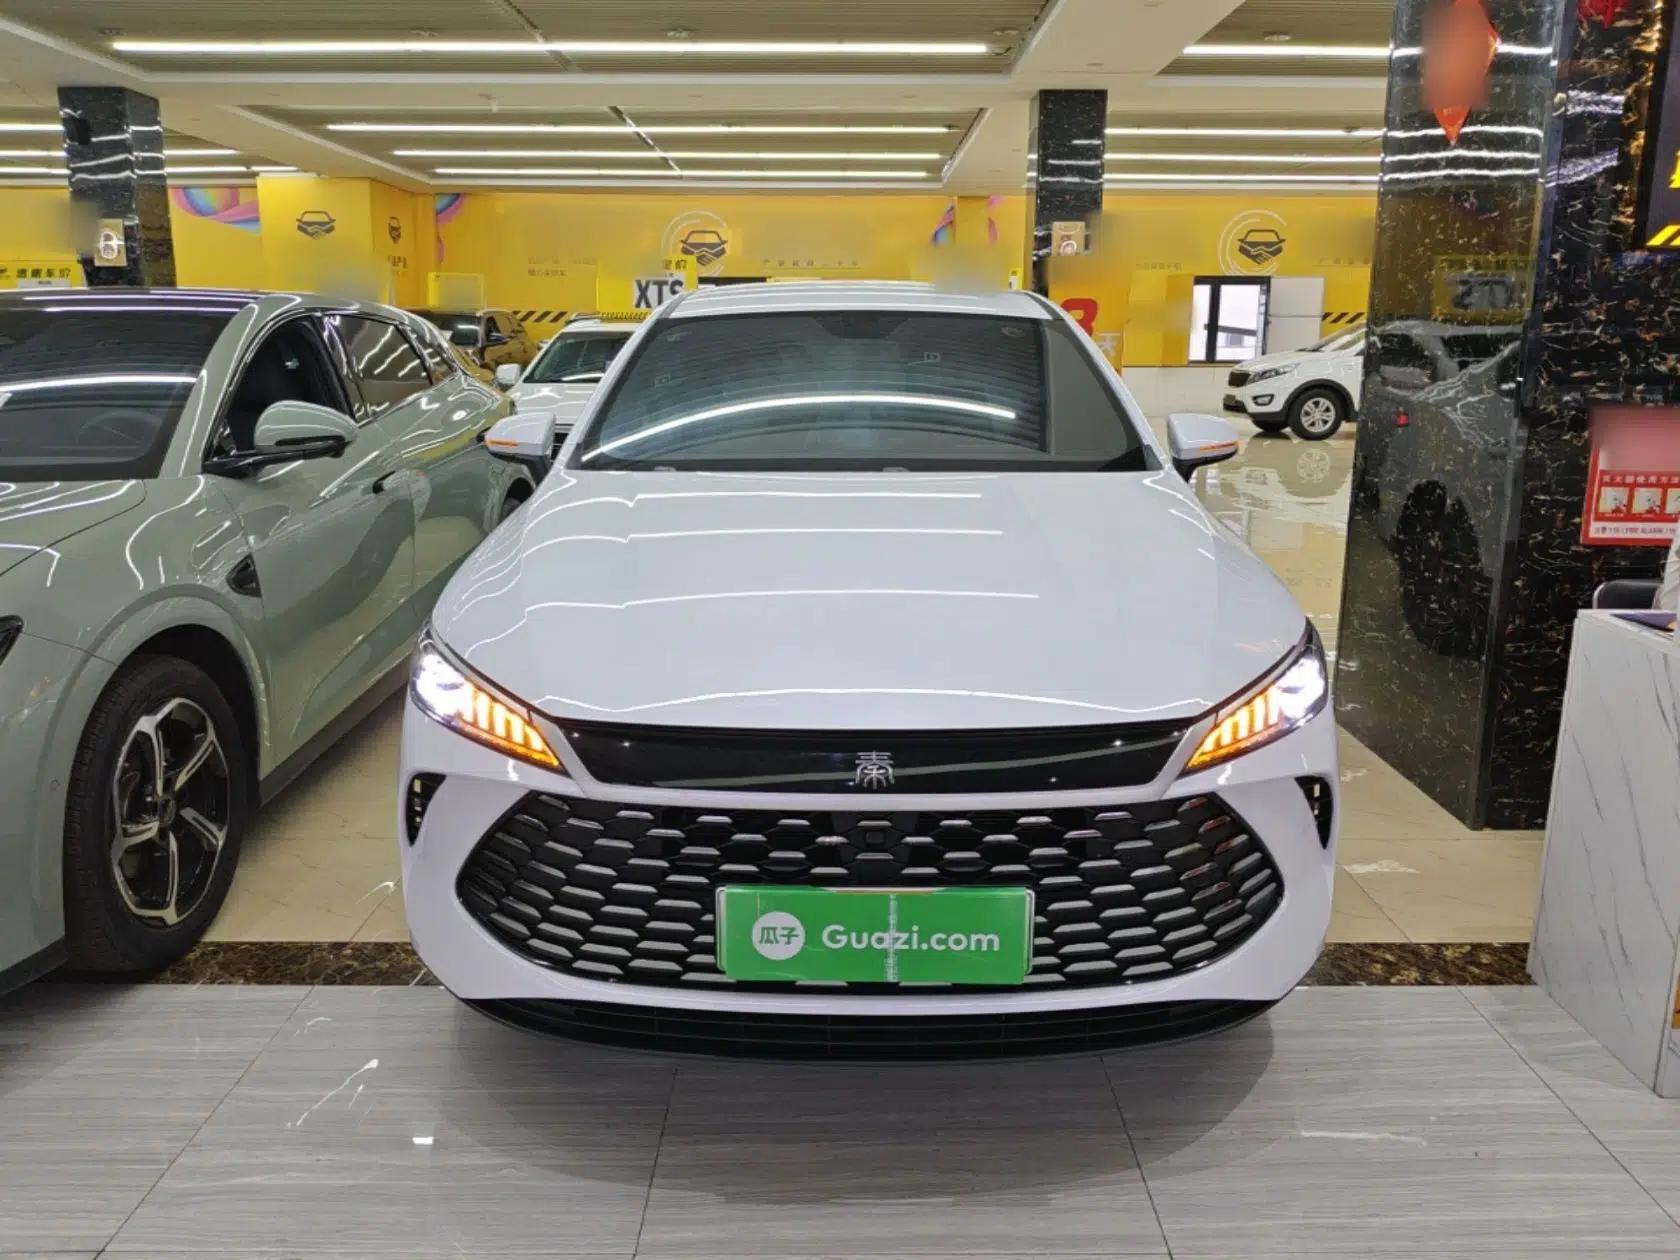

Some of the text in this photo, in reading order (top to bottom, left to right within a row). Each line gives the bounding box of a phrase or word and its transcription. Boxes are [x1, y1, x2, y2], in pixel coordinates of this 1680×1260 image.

[855, 750, 894, 789] 秦
[759, 924, 1000, 951] 瓜子 Guazi.com
